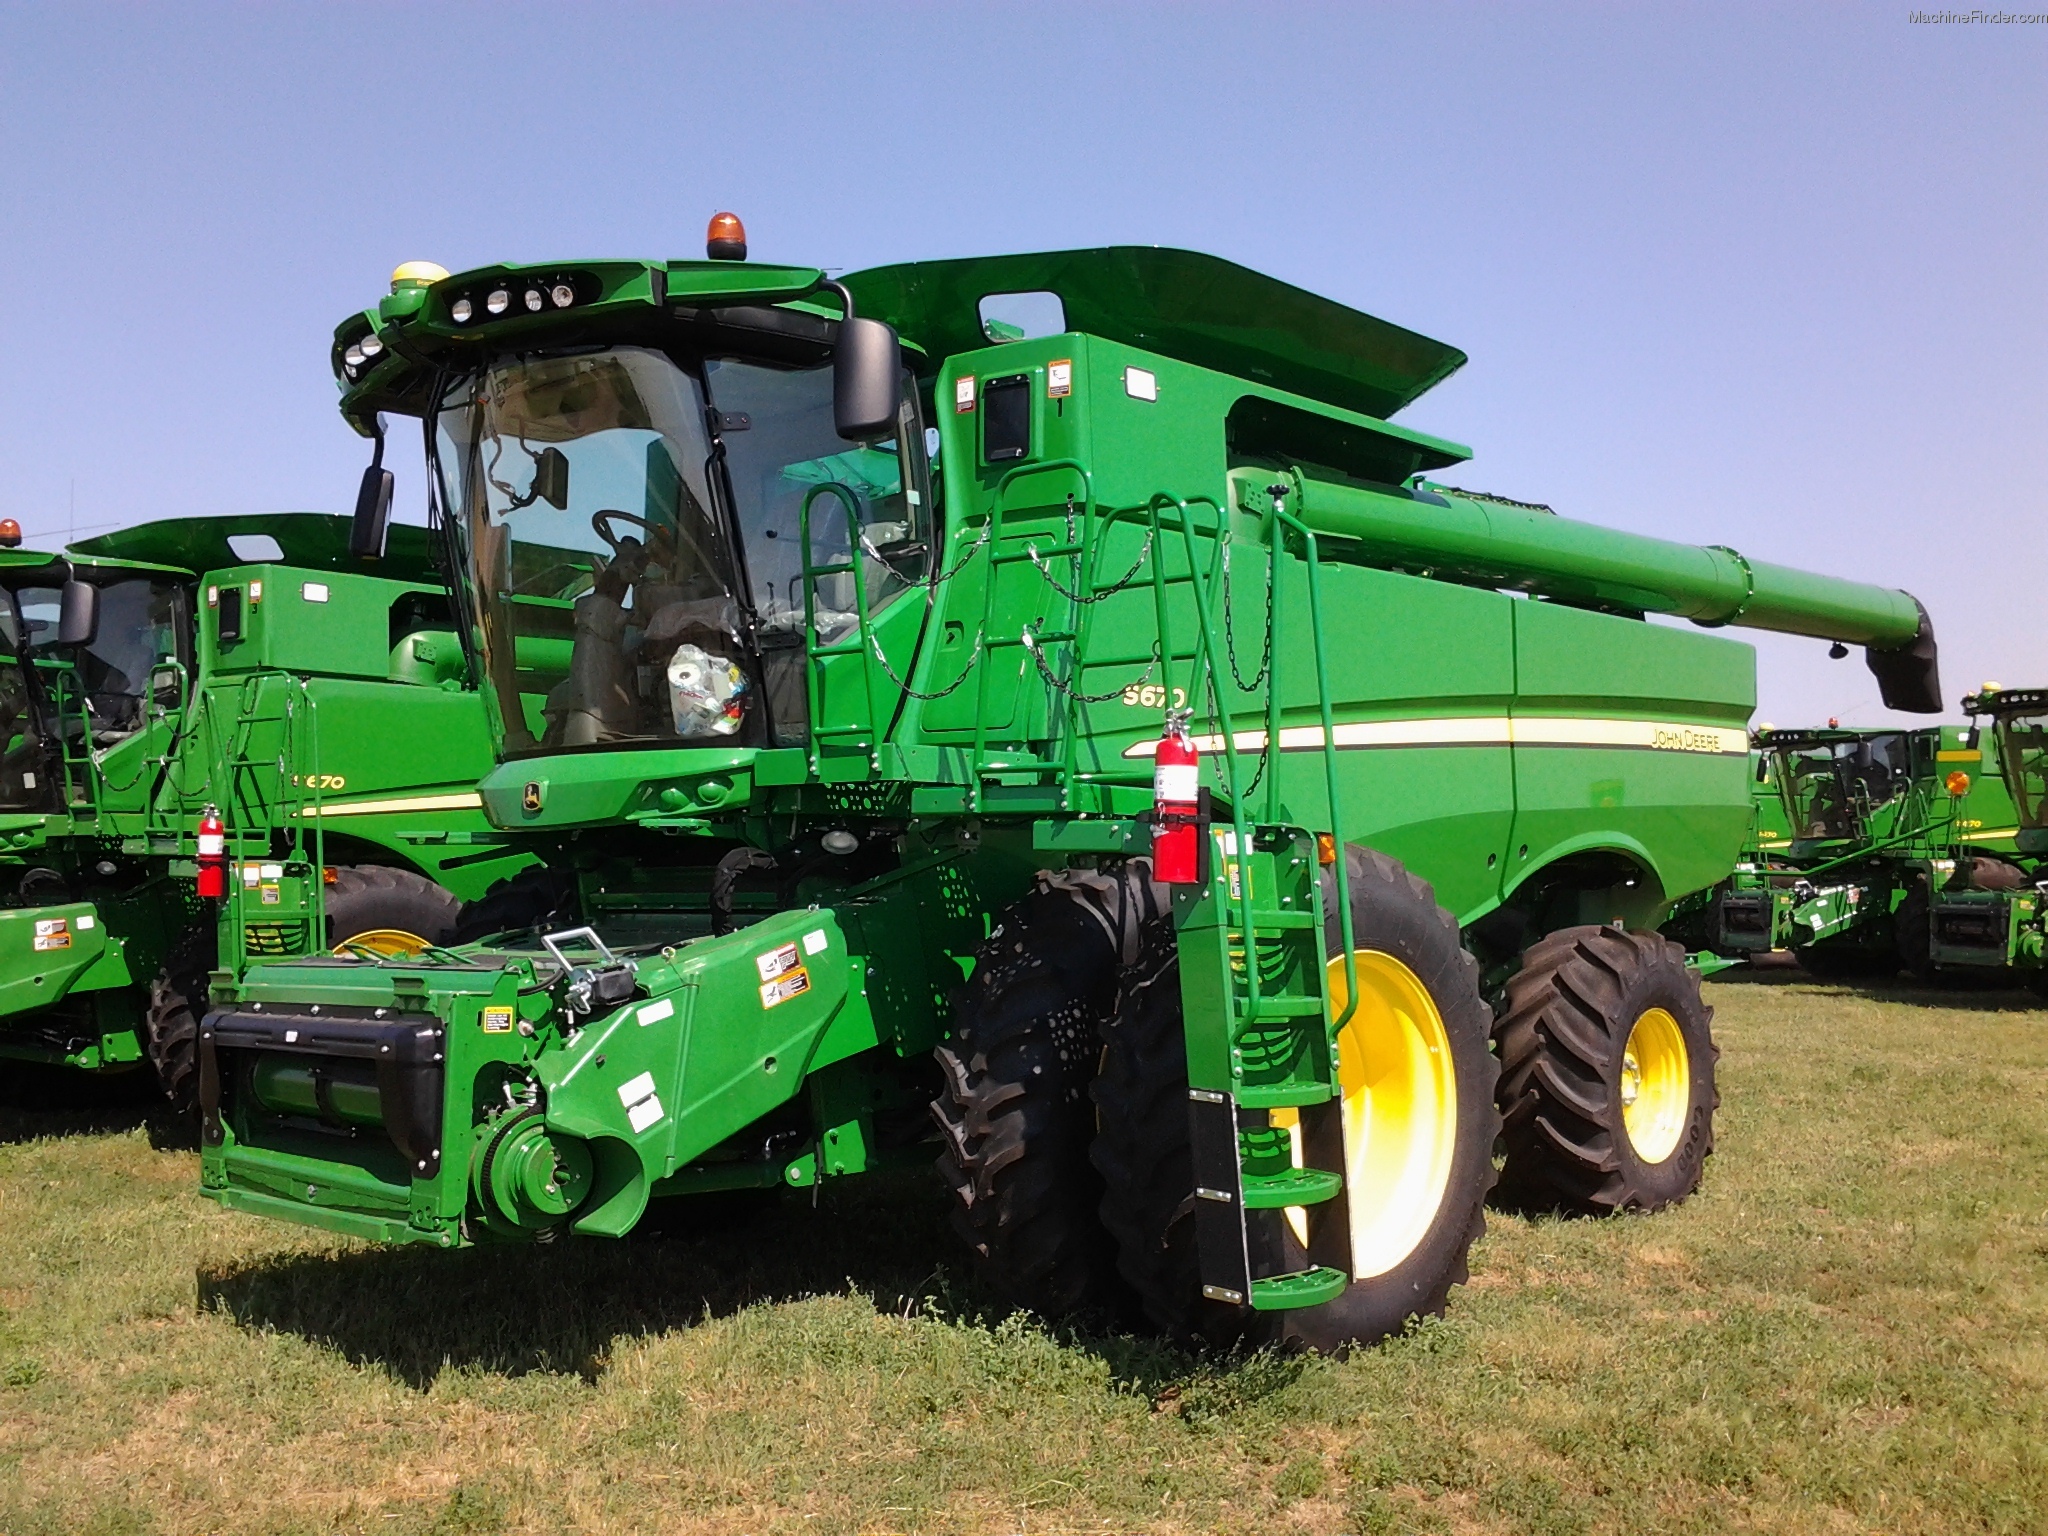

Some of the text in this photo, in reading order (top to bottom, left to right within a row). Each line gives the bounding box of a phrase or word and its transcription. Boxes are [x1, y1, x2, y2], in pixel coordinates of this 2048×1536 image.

[1123, 685, 1185, 709] S670
[1652, 729, 1721, 752] JOHN DEERE
